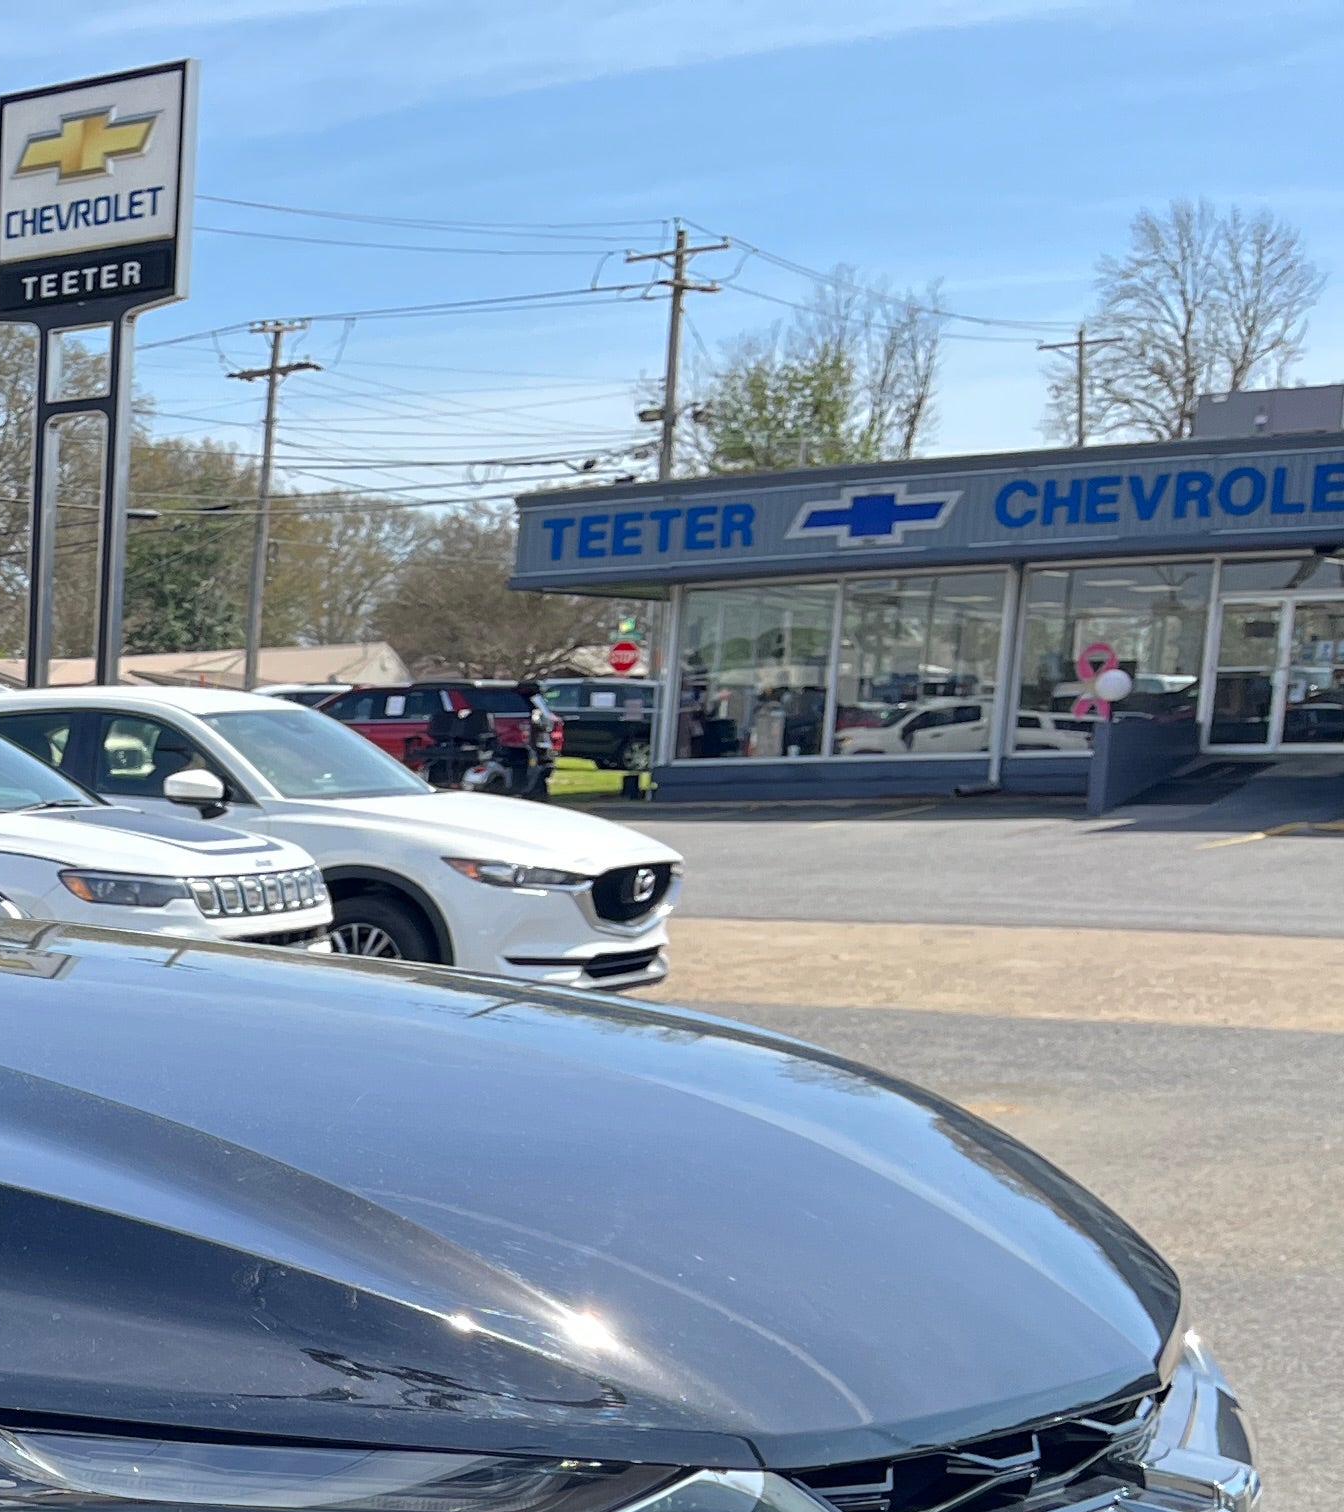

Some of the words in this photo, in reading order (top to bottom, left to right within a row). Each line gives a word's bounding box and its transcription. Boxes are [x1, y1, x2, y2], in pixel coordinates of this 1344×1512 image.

[6, 186, 165, 239] CHEVROLET
[21, 261, 141, 300] TEETER
[542, 503, 755, 561] TEETER
[994, 462, 1344, 528] CHEVROLE
